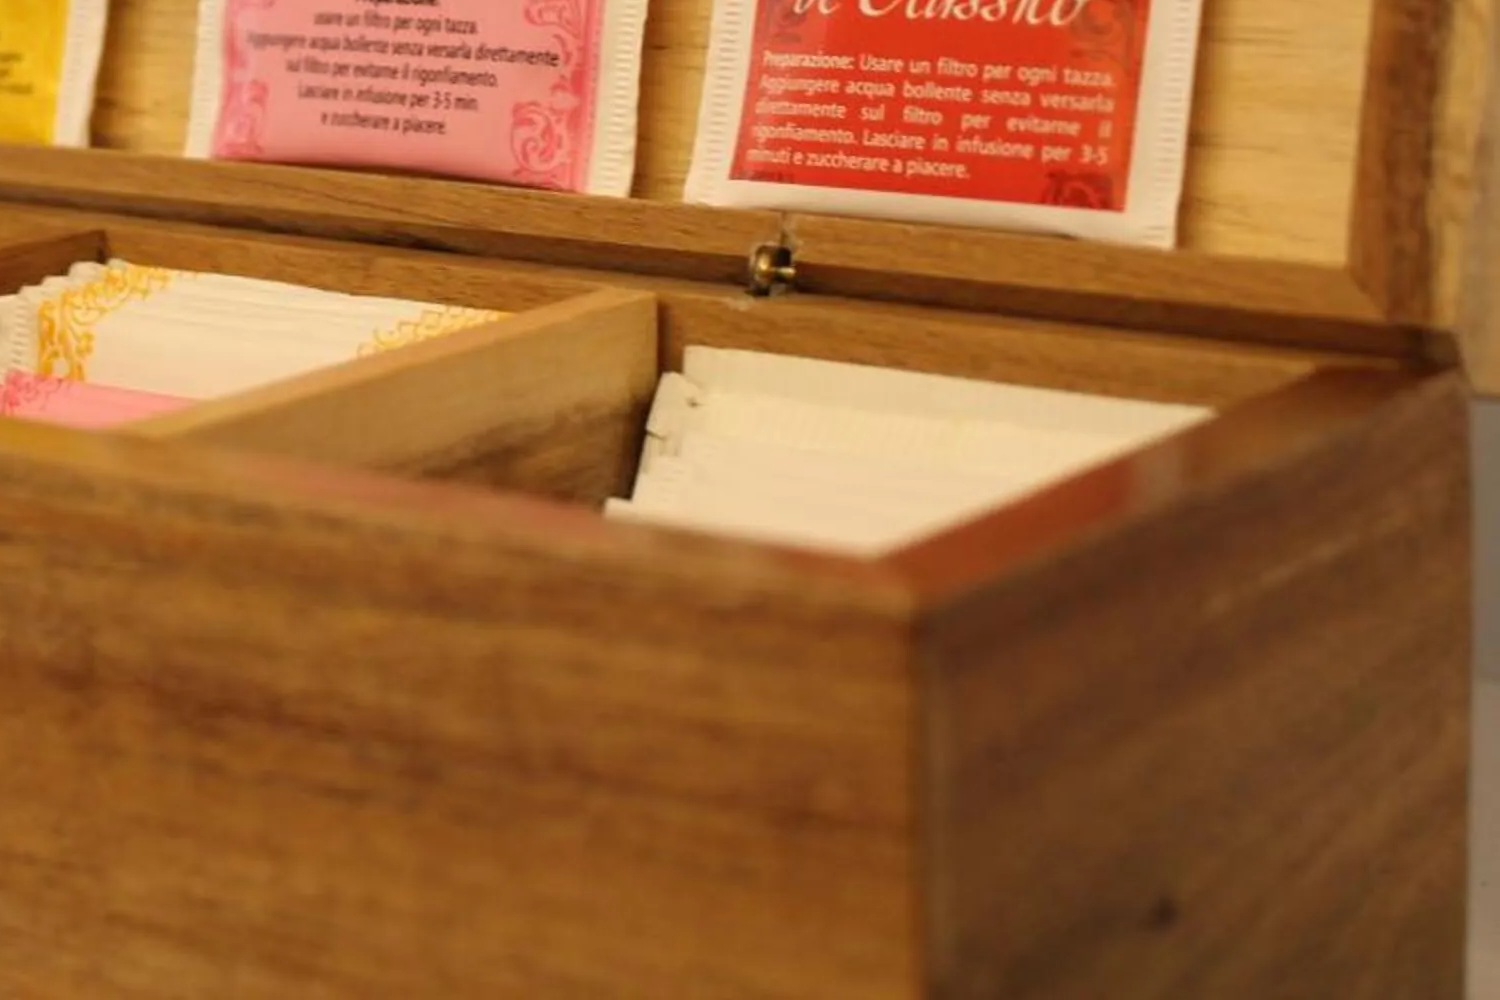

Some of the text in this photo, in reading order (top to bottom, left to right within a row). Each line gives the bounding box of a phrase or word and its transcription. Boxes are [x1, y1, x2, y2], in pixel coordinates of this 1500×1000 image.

[475, 42, 559, 67] direttamente
[859, 52, 904, 73] Usare
[909, 60, 931, 74] un
[937, 56, 978, 78] filtro
[982, 64, 1012, 83] per
[1017, 64, 1057, 87] ogni
[1063, 67, 1115, 88] tazza.
[845, 80, 895, 100] acqua
[903, 79, 973, 103] bollente
[980, 89, 1031, 106] senza
[1039, 92, 1115, 113] versarla
[859, 103, 885, 121] sul
[903, 104, 943, 126] filtro
[961, 113, 992, 132] per
[1006, 114, 1081, 136] evitarne
[1098, 119, 1112, 139] il
[793, 151, 804, 165] e
[806, 149, 888, 172] zuccherare
[892, 158, 902, 173] a
[906, 156, 971, 179] piacere.
[862, 129, 926, 151] Lasciare
[932, 133, 949, 151] in
[955, 134, 1034, 160] infusione
[1041, 145, 1071, 164] per
[1079, 143, 1108, 166] 3-5
